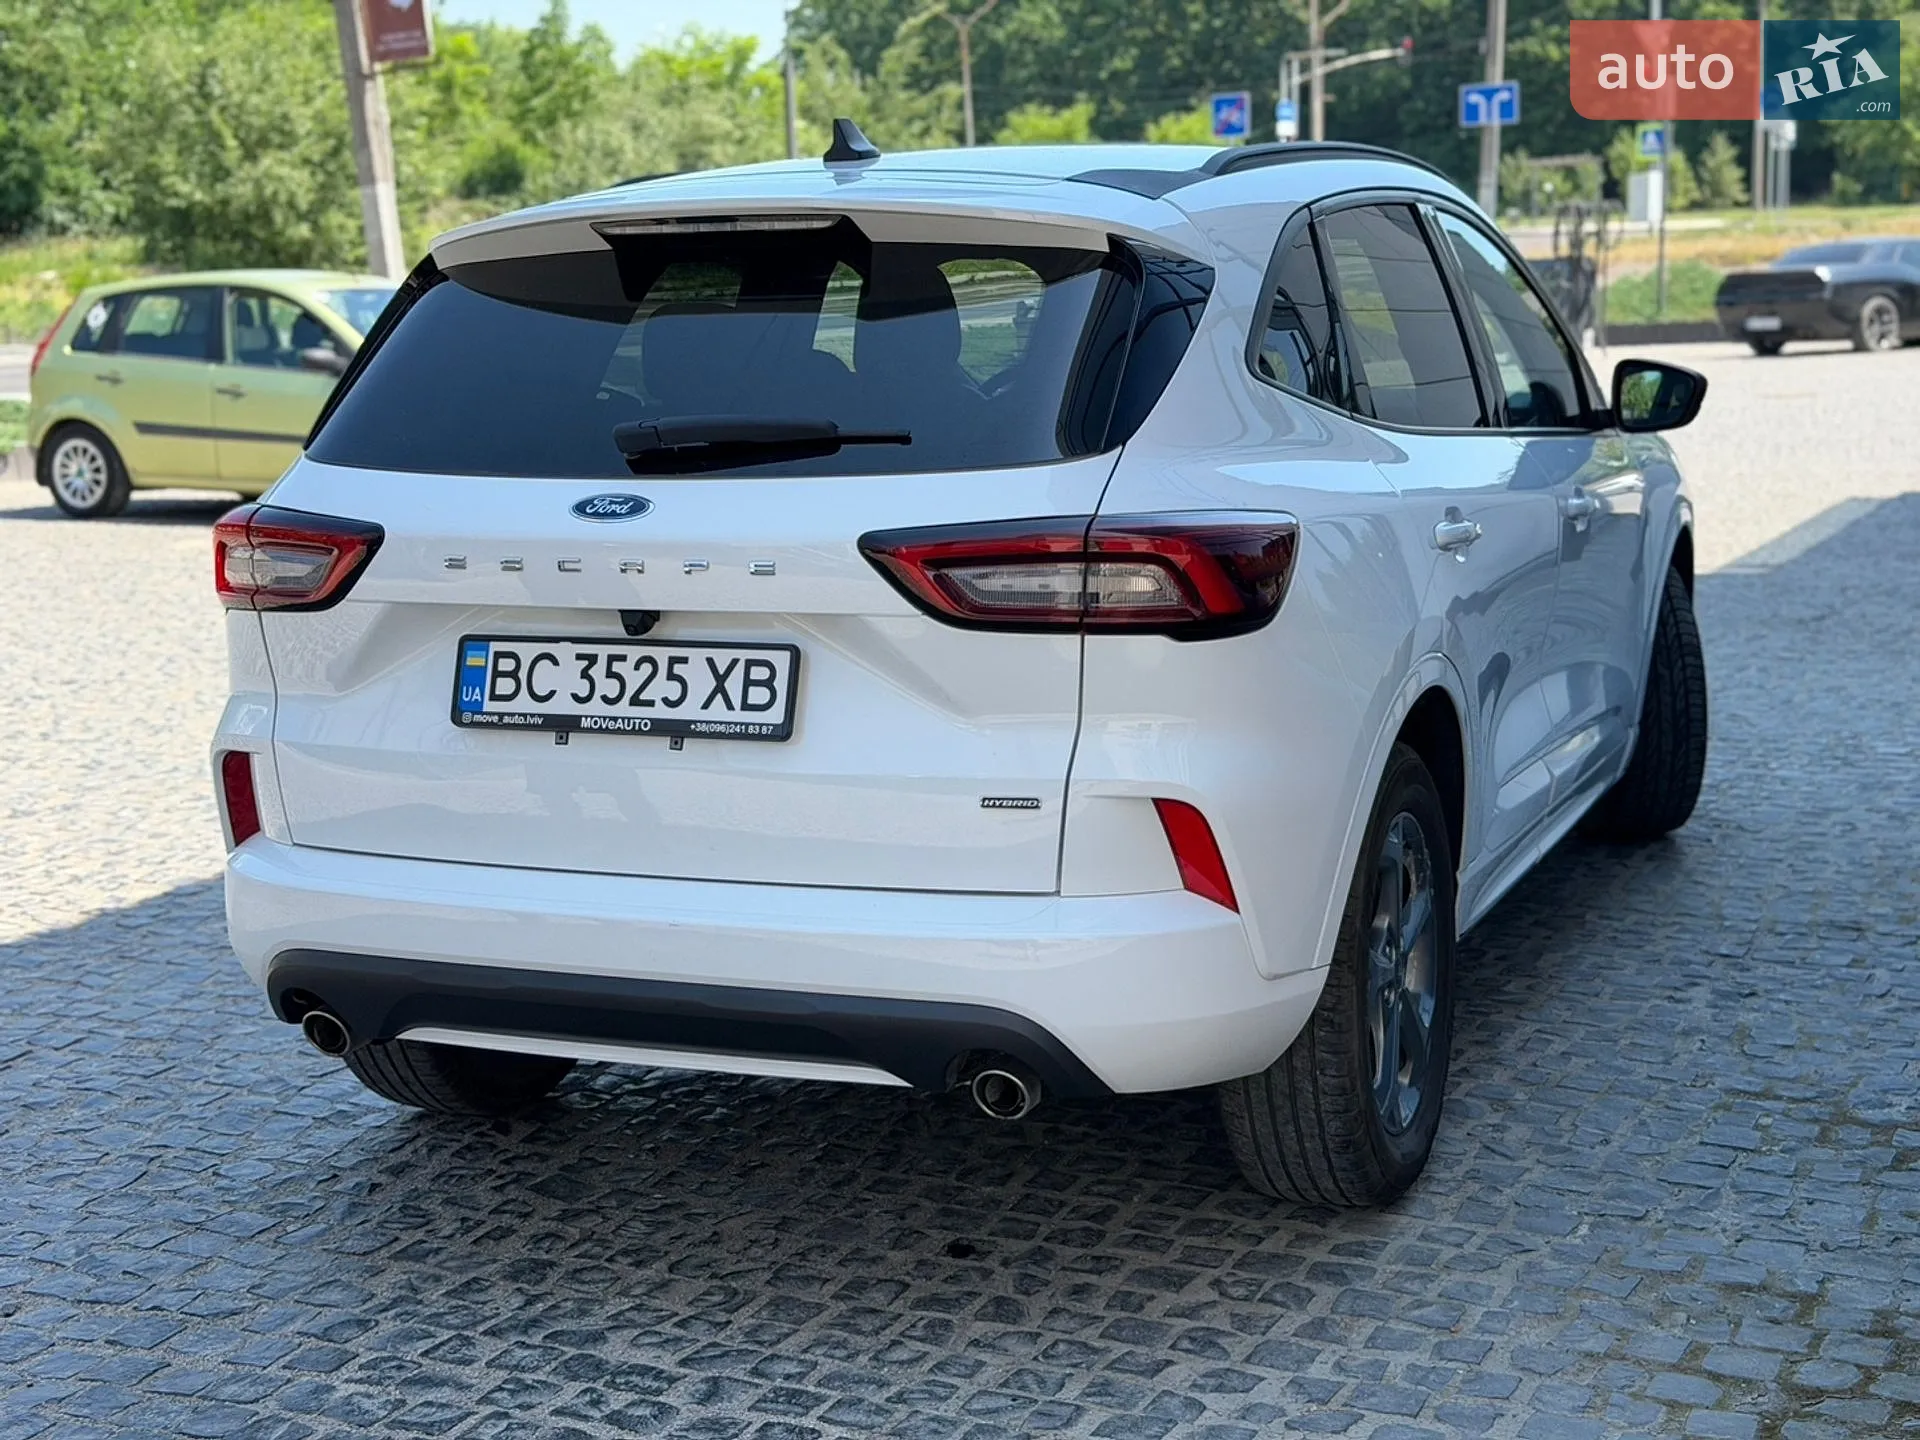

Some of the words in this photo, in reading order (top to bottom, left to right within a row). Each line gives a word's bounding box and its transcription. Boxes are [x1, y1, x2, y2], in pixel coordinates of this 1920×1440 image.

[585, 497, 635, 514] Ford
[444, 555, 776, 576] ESCAPE
[488, 650, 560, 703] BC
[570, 653, 689, 709] 3525
[700, 656, 778, 712] XB
[462, 686, 482, 702] UA
[473, 712, 544, 725] move_auto.lviv
[581, 717, 651, 731] MOVeAUTO
[983, 799, 1038, 808] HYBRID
